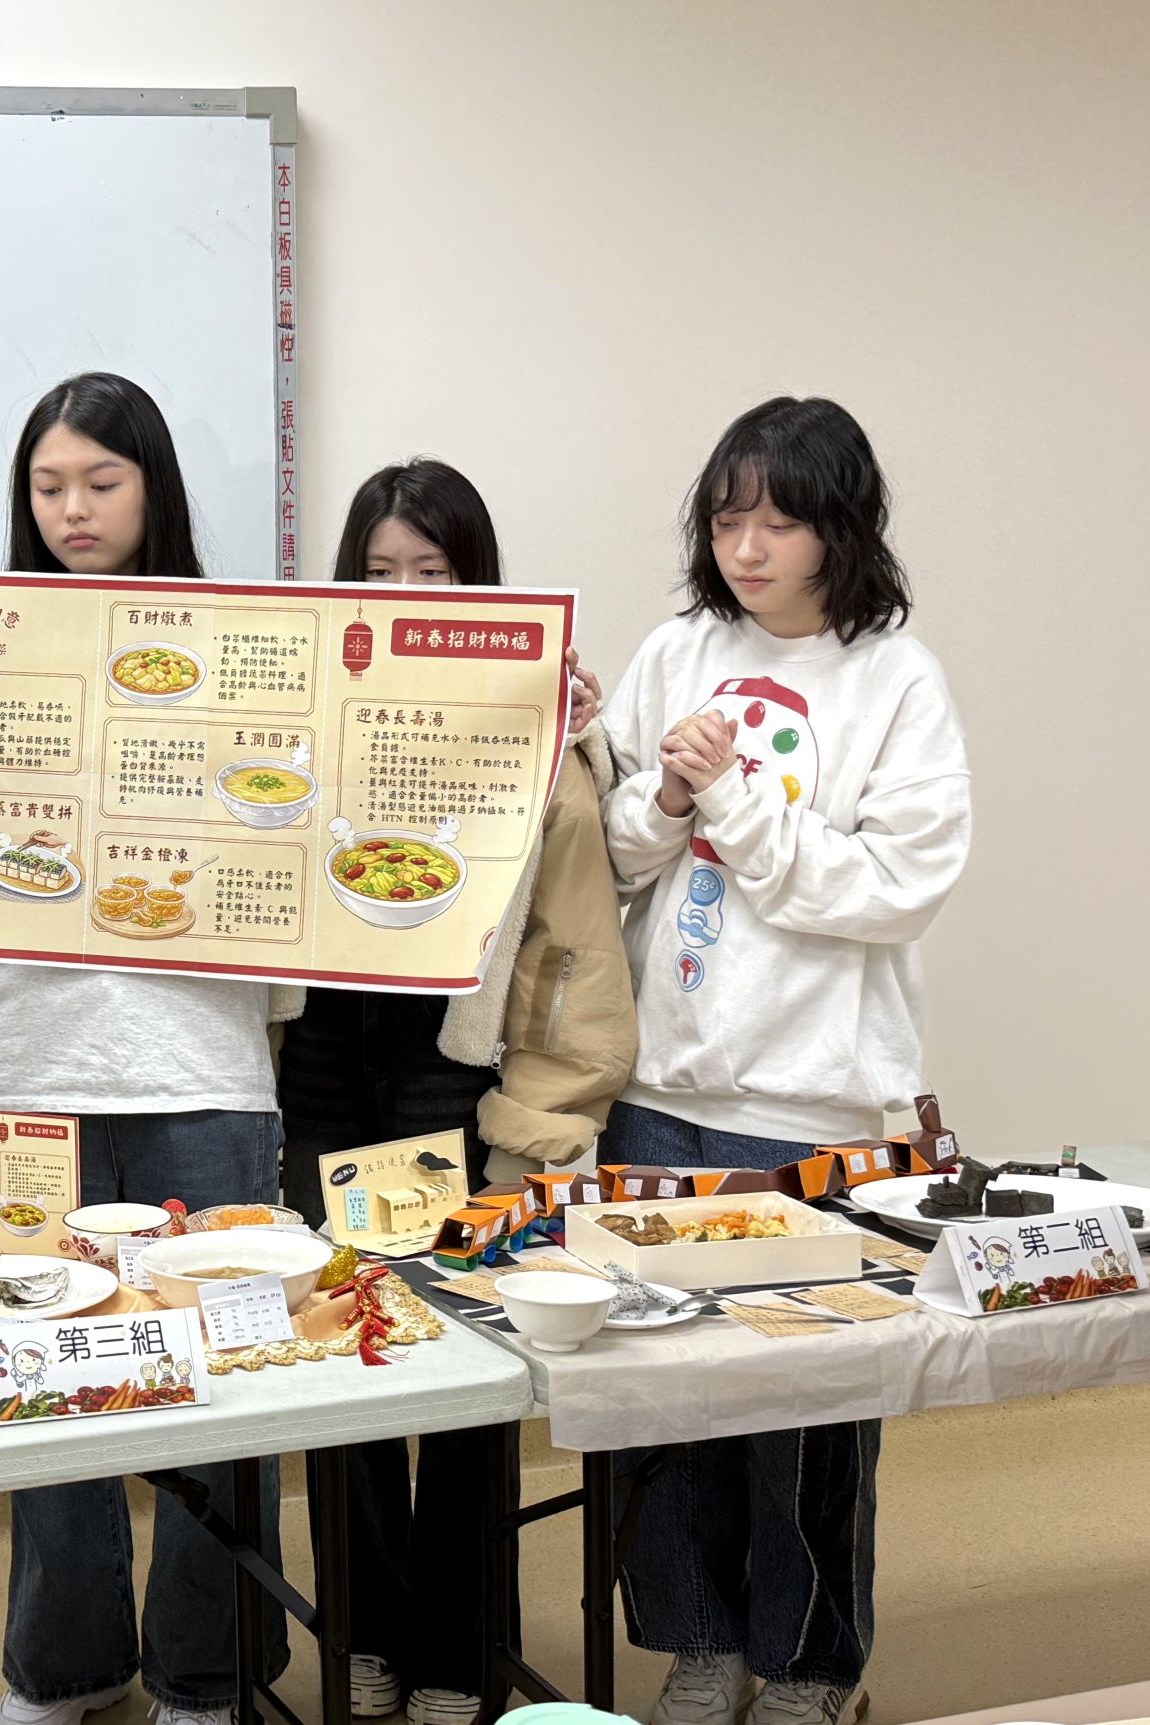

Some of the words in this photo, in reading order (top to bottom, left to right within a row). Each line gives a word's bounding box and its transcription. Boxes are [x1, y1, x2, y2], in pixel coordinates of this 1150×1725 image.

[127, 609, 193, 627] 百財燉煮
[404, 628, 530, 650] 新春招財納福
[355, 707, 445, 727] 迎春長壽湯
[233, 731, 299, 749] 玉潤圓滿
[381, 814, 403, 822] HTN
[107, 844, 190, 863] 吉祥金橙凍
[267, 905, 274, 913] C
[331, 1165, 356, 1183] MENU
[1018, 1217, 1109, 1259] 第二組
[55, 1320, 168, 1363] 第三組
